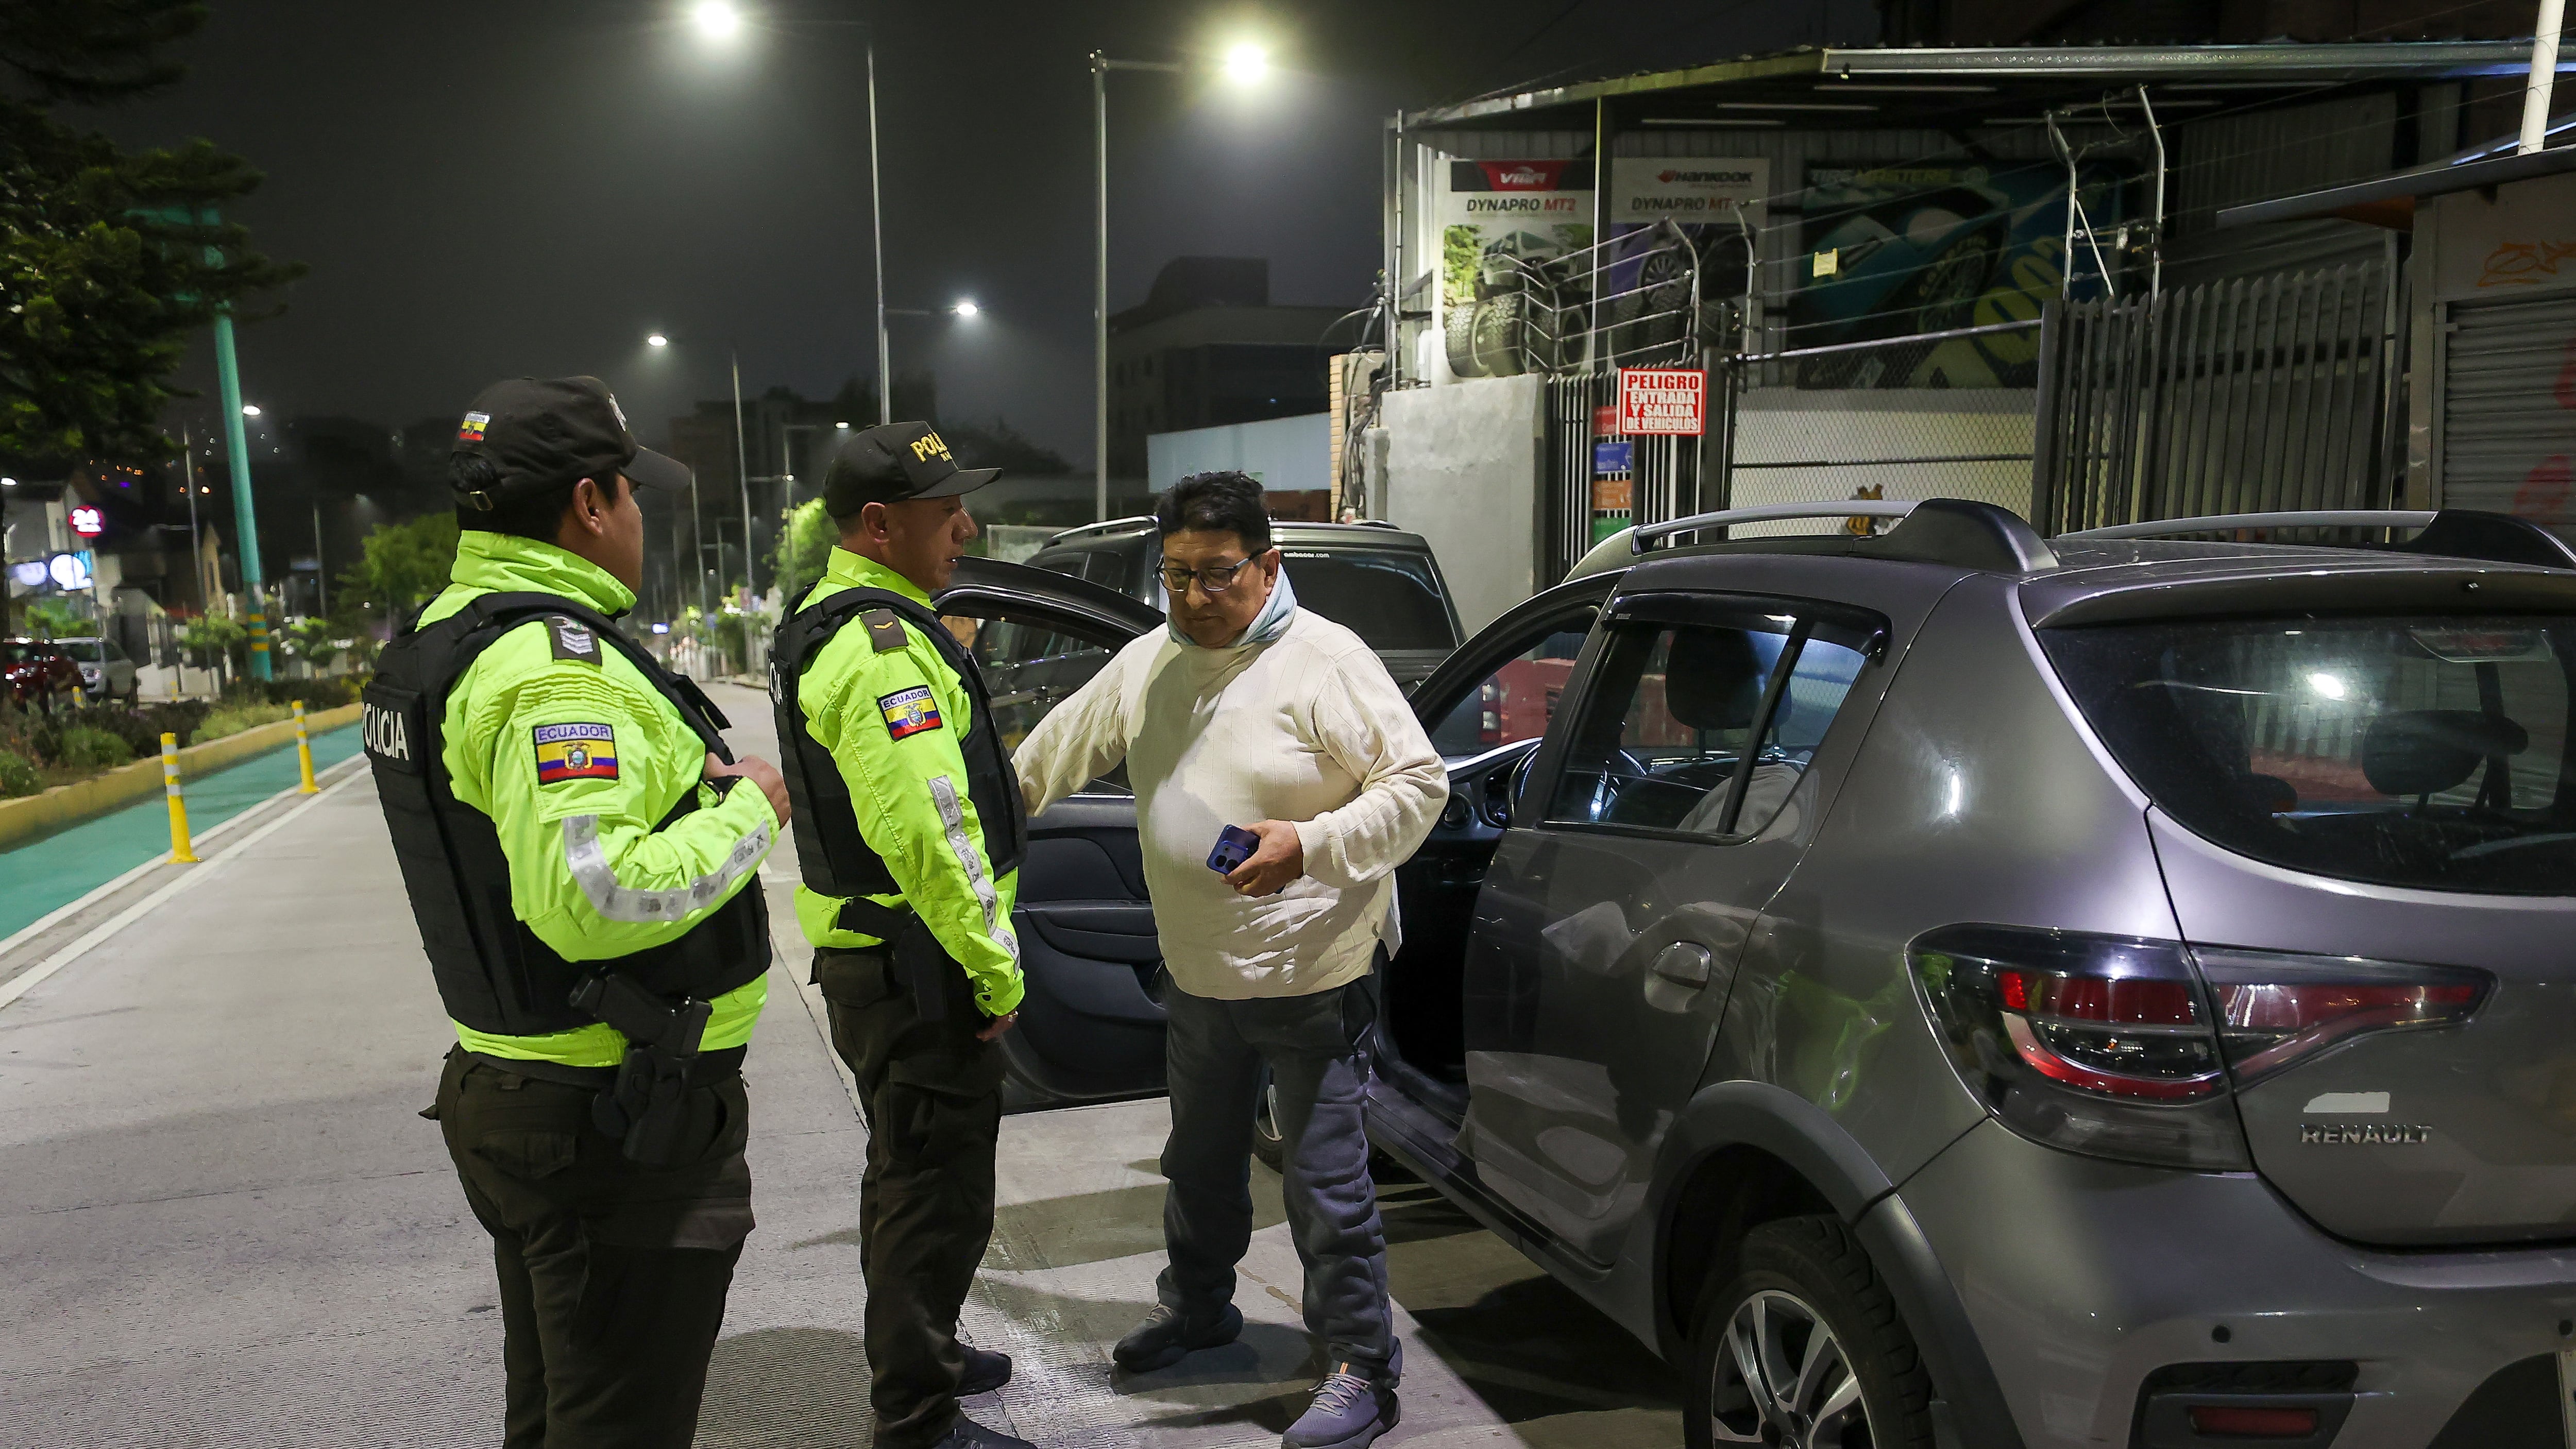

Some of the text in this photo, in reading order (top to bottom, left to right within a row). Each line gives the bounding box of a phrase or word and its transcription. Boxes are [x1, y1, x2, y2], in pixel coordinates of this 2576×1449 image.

[1467, 198, 1540, 211] DYNAPRO
[1631, 197, 1705, 210] DYNAPRO
[1628, 375, 1699, 389] PELIGRO
[1630, 391, 1696, 404] ENTRADA
[1630, 404, 1694, 417] Y SALIDA
[1626, 417, 1640, 430] DE
[884, 690, 929, 708] ECUADOR
[538, 725, 609, 741] ECUADOR
[2300, 1123, 2433, 1144] RENAULT
